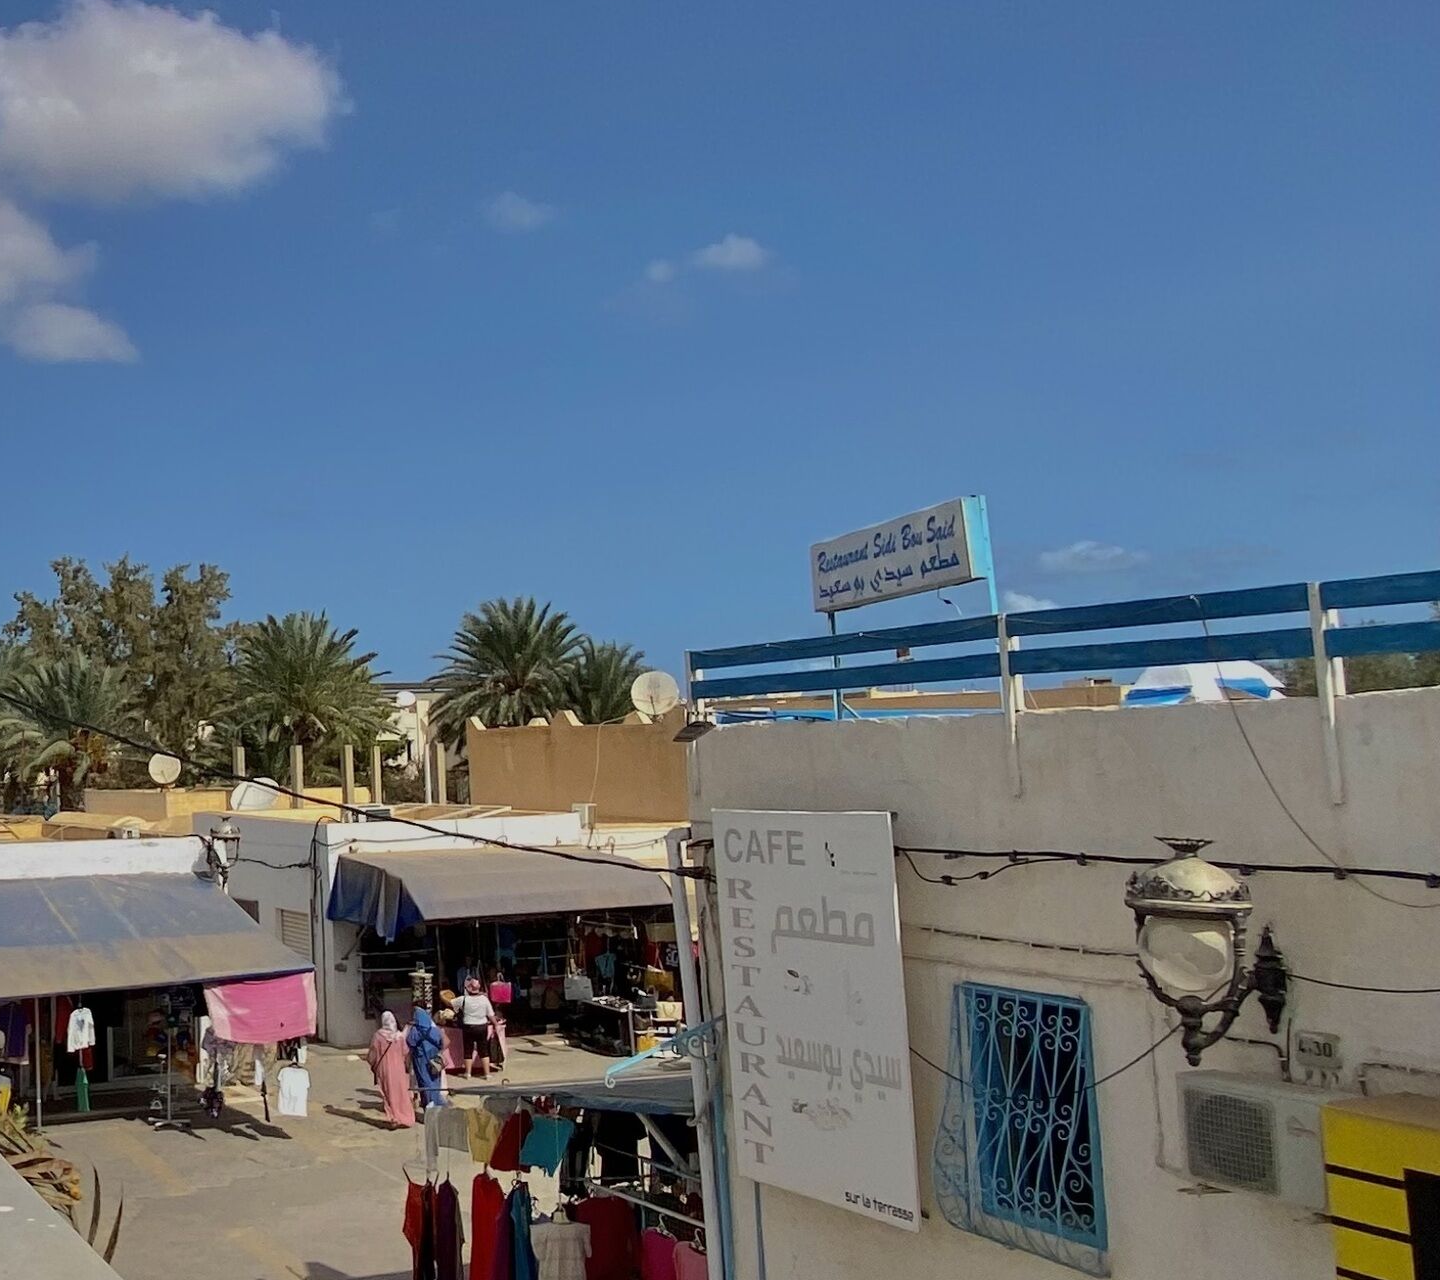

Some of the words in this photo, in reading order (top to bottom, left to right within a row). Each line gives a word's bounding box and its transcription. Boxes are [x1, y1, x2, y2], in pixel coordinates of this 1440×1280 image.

[818, 541, 868, 573] Restaurant
[873, 532, 896, 558] Sidi
[901, 524, 922, 550] Bou
[926, 515, 955, 543] Said
[921, 543, 960, 579] مطعم
[870, 564, 914, 594] سيدي
[724, 828, 806, 866] CAFE
[771, 895, 875, 954] مطعم
[725, 877, 775, 1165] RESTAURANT
[850, 1048, 902, 1103] سيدي
[844, 1191, 860, 1205] sur
[862, 1192, 871, 1209] la
